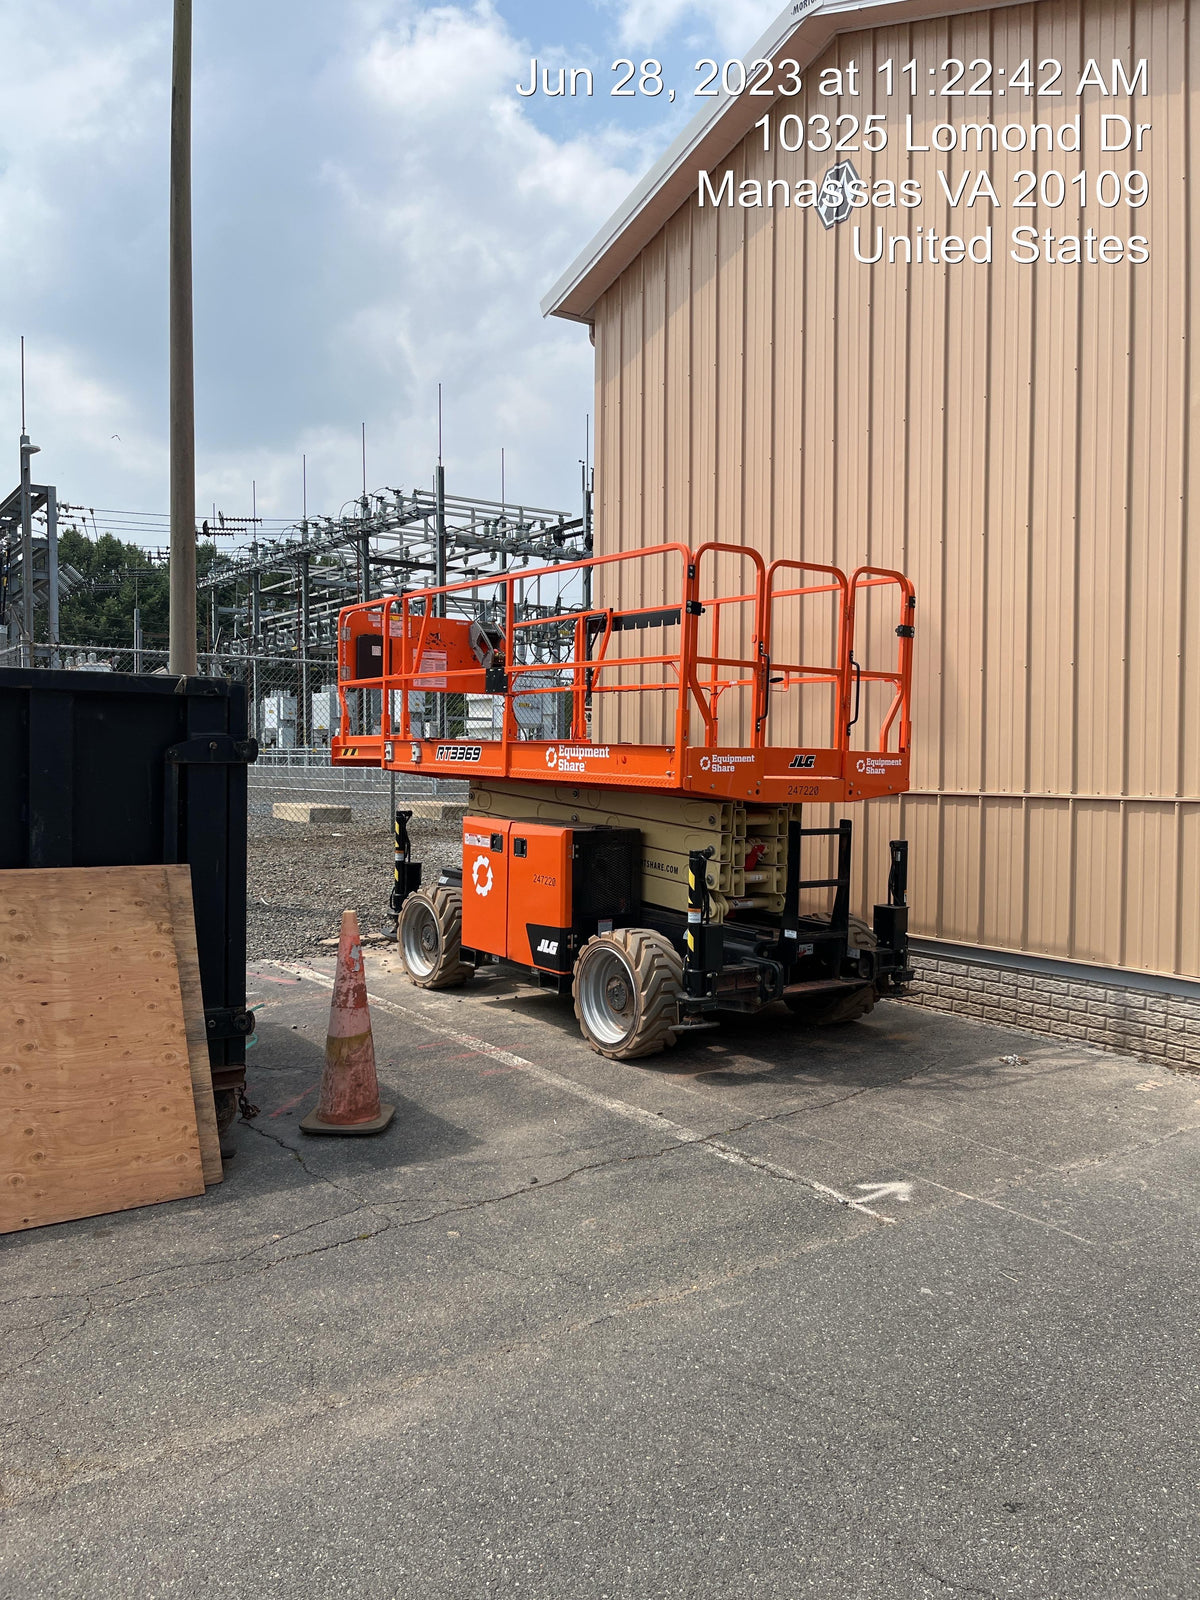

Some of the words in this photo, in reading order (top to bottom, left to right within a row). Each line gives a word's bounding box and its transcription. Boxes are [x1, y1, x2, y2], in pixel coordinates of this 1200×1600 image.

[436, 745, 482, 762] RT3369
[558, 744, 610, 760] Equipment
[558, 759, 585, 772] Share
[711, 754, 755, 764] Equipment
[789, 755, 816, 768] JLG
[866, 758, 902, 767] Equipment
[711, 764, 735, 772] Share
[866, 766, 886, 774] Share
[787, 785, 819, 796] 247220
[532, 873, 557, 887] 247220
[536, 938, 559, 956] JLG
